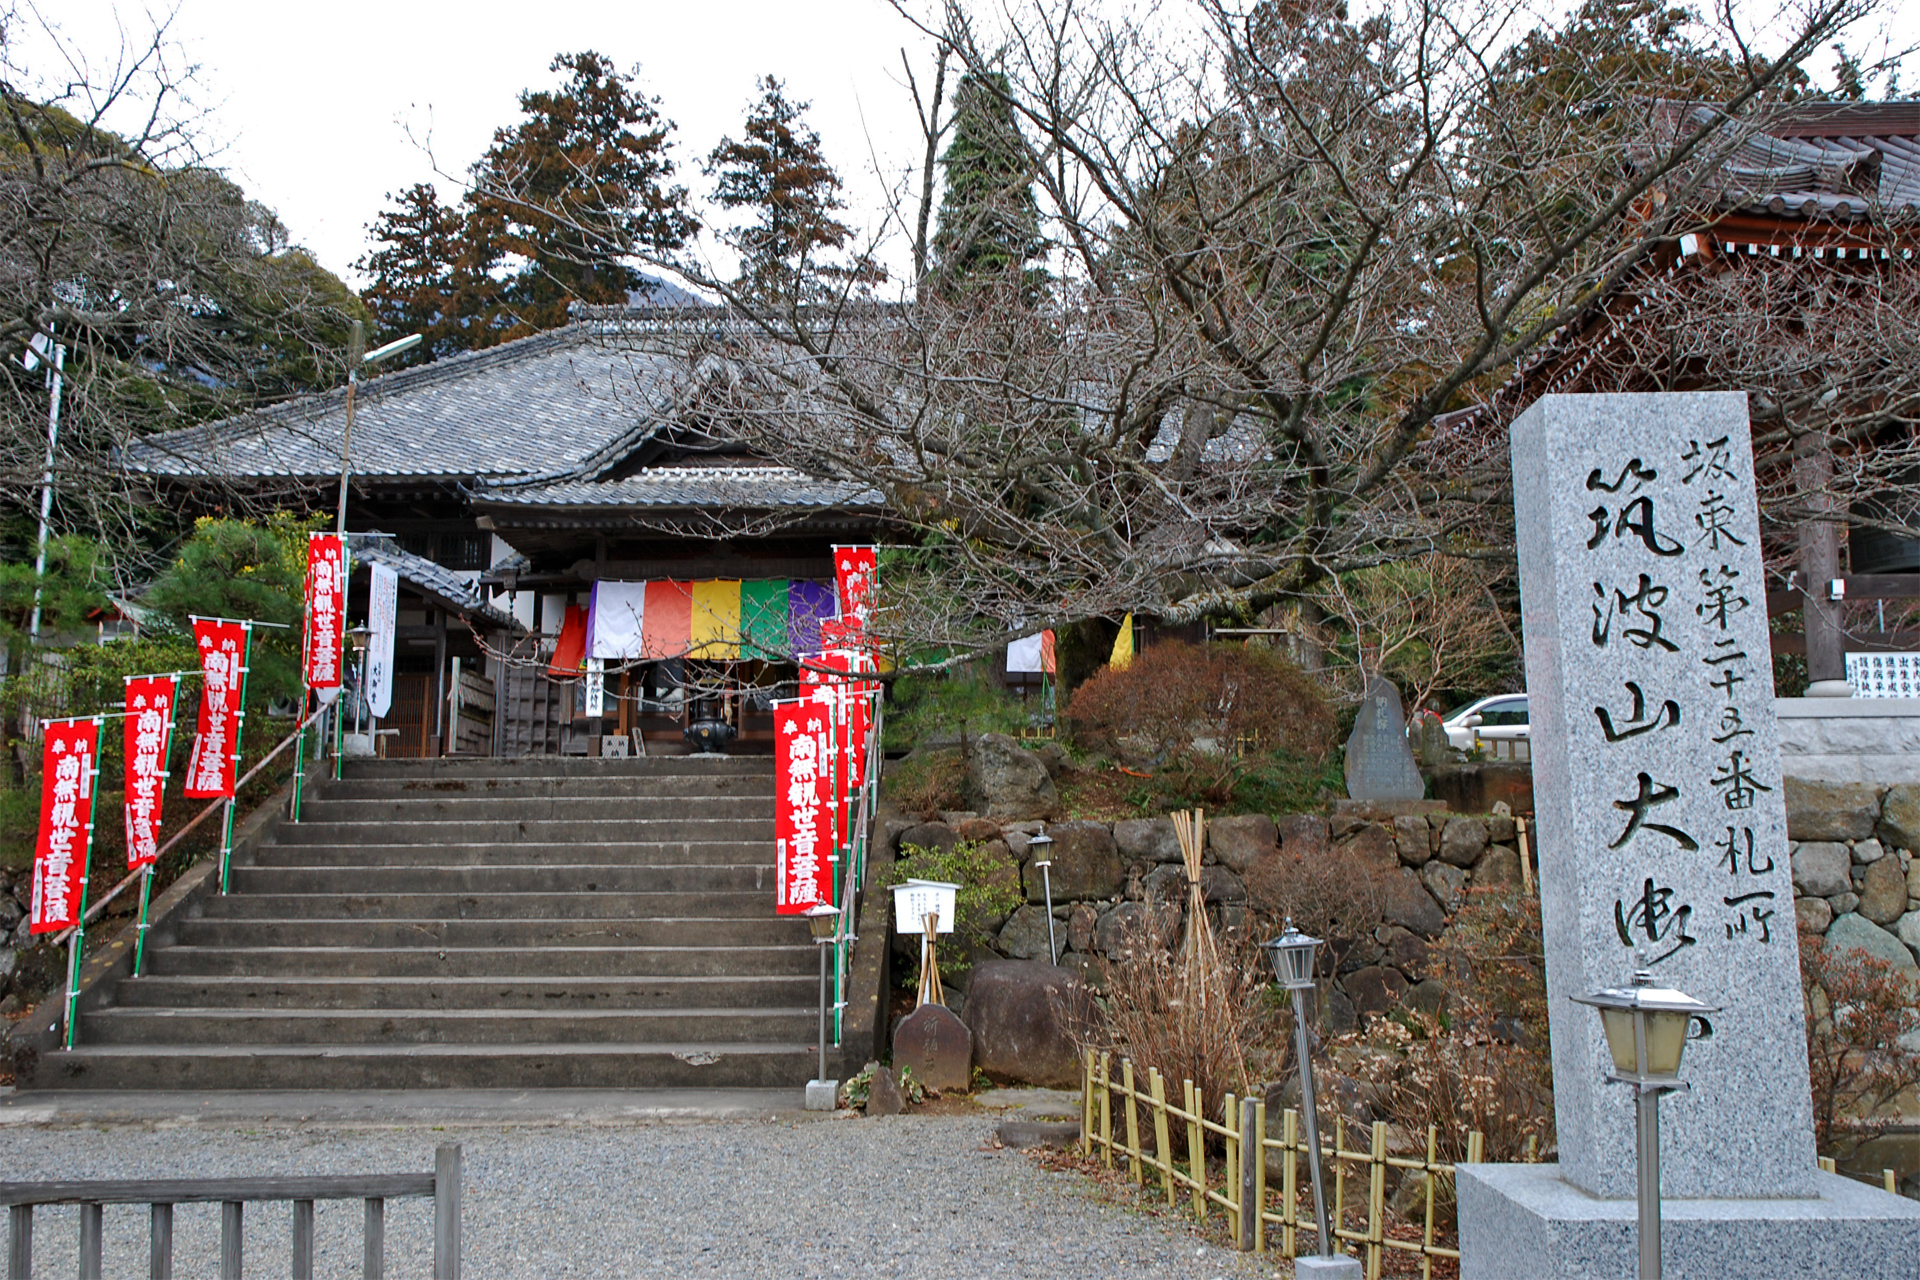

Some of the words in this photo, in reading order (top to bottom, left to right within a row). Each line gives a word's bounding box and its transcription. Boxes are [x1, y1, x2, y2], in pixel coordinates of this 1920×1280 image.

[313, 559, 337, 682] 南無観世音菩薩
[199, 634, 236, 652] 奉納
[1682, 436, 1773, 944] 坂東第二十五番札所
[1859, 656, 1871, 698] 護摩執
[1872, 656, 1884, 698] 傷病平
[1885, 656, 1897, 698] 進学成
[1898, 656, 1911, 698] 出生安
[132, 694, 167, 709] 奉納
[51, 738, 88, 754] 奉納
[783, 717, 822, 735] 奉納
[1587, 457, 1713, 1041] 筑波山大御
[44, 754, 80, 923] 南無観世音菩薩
[787, 733, 820, 905] 南無観世音菩薩
